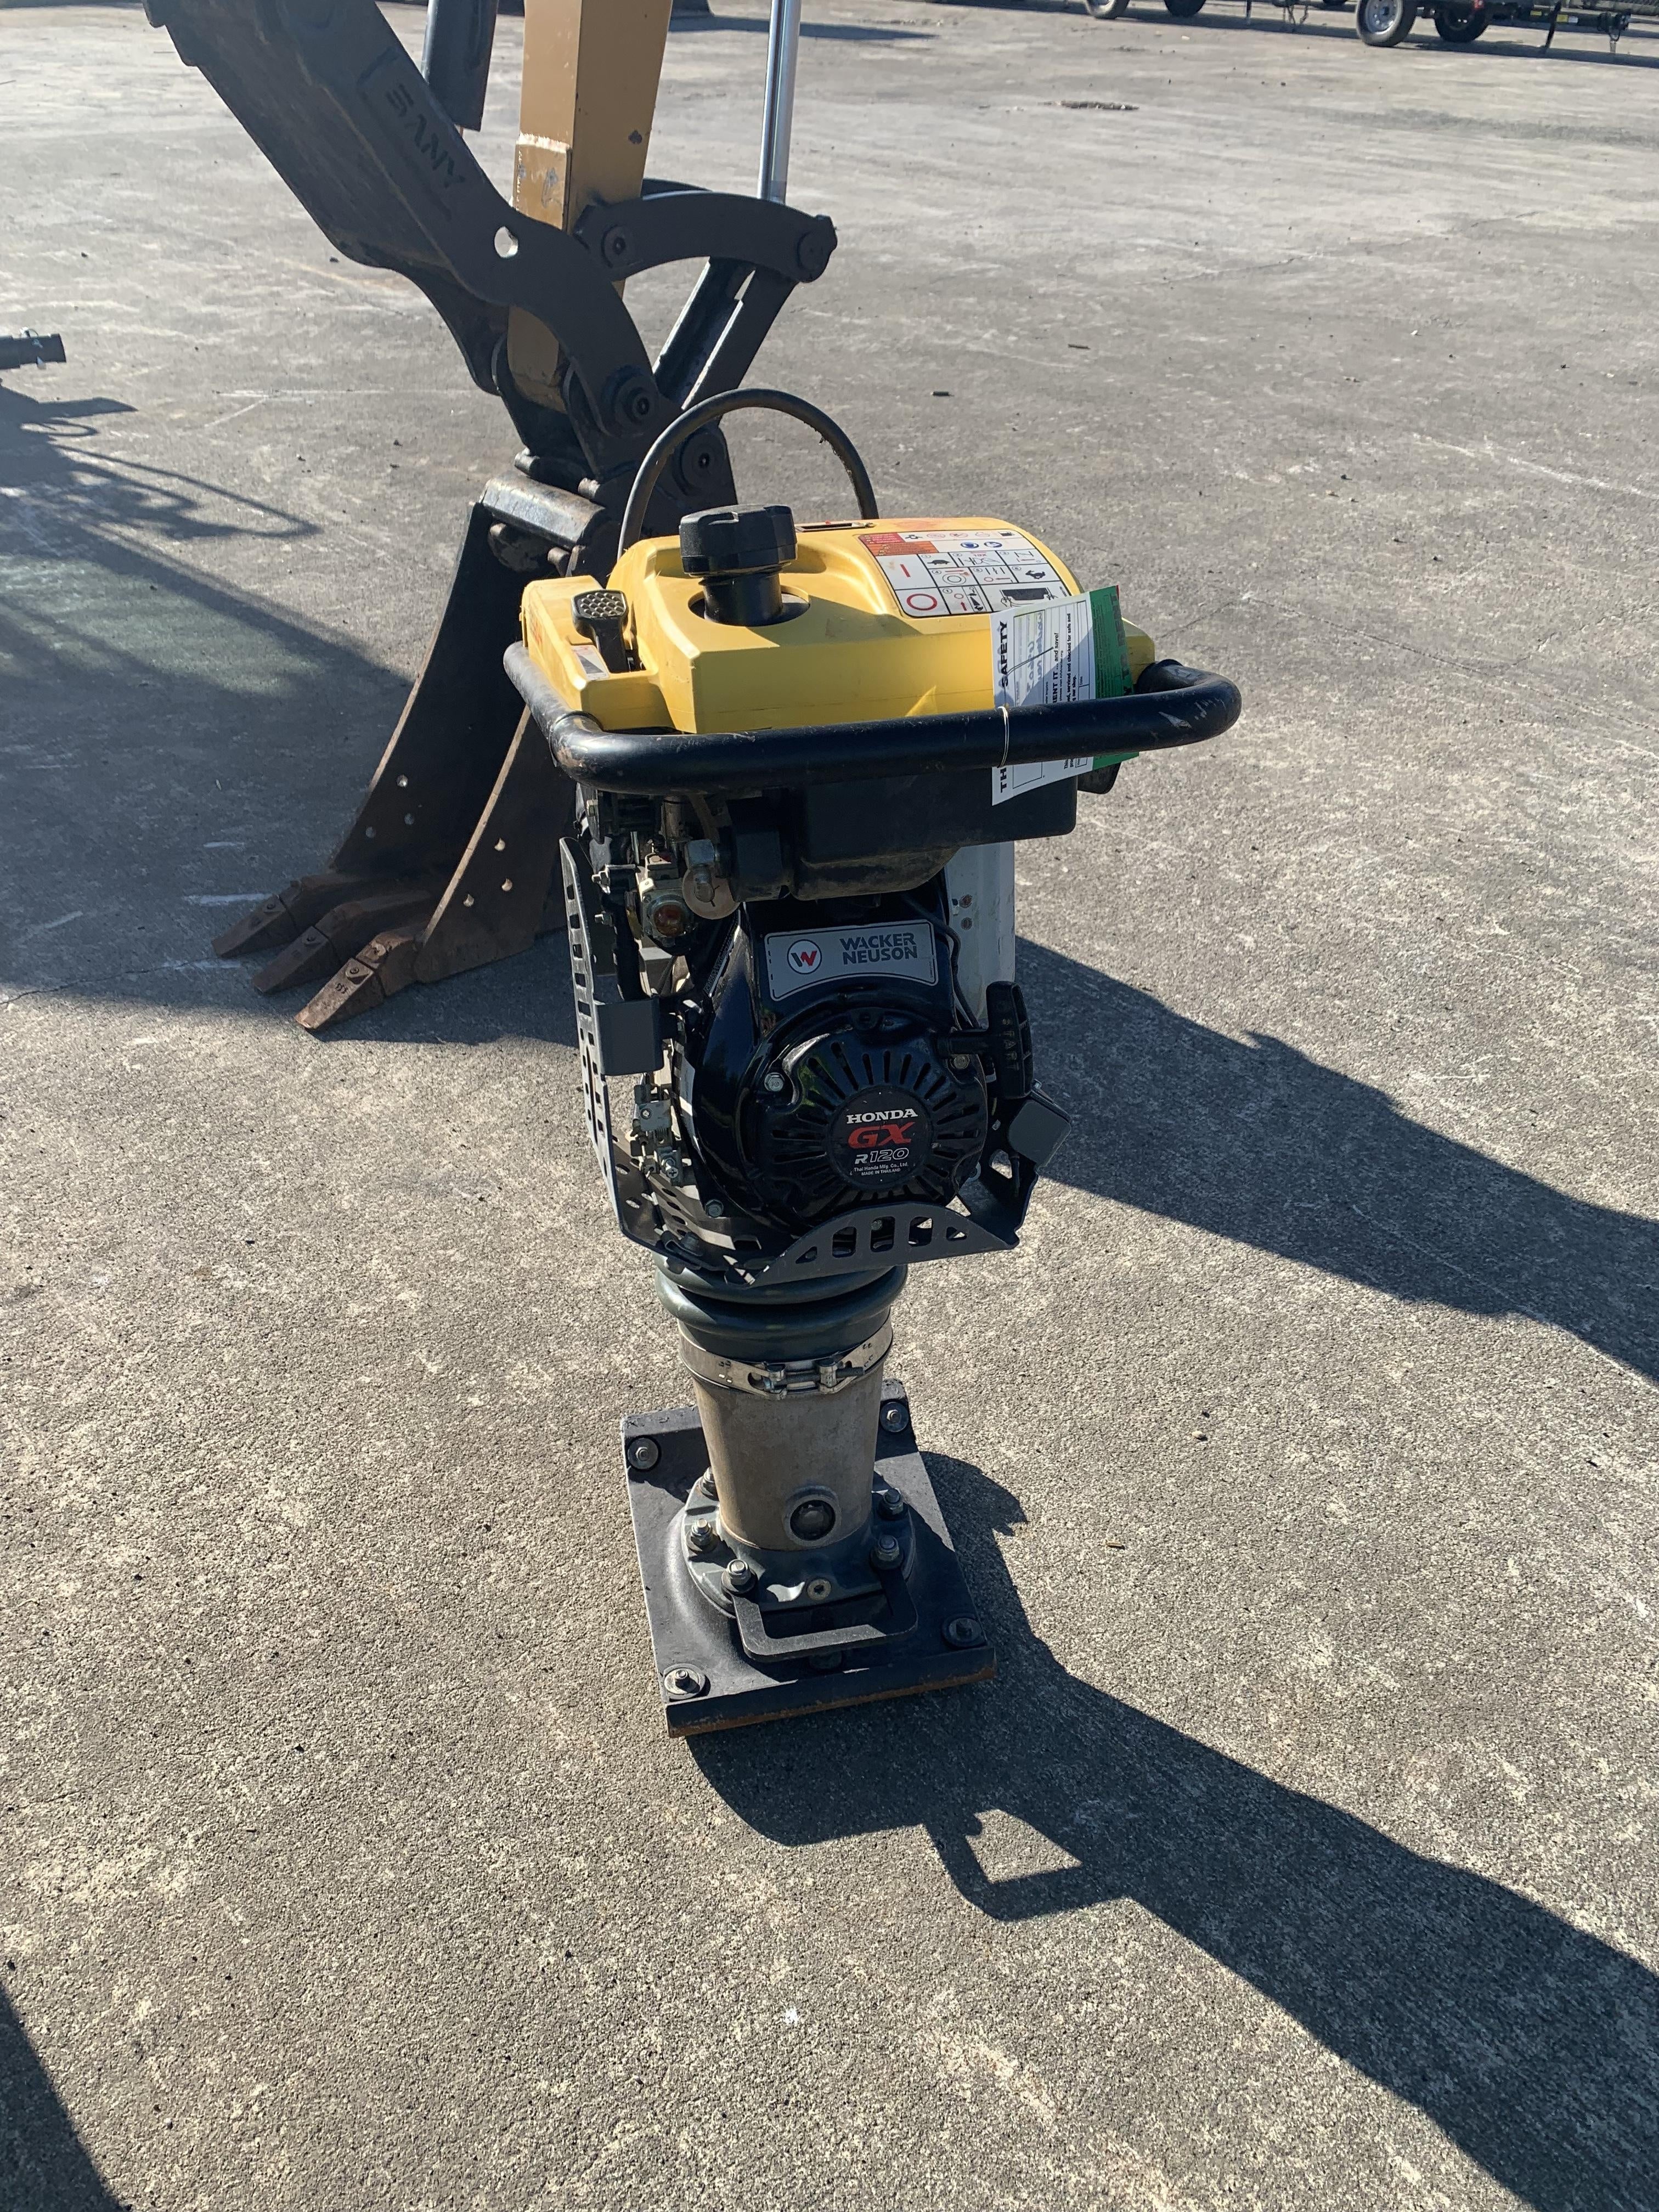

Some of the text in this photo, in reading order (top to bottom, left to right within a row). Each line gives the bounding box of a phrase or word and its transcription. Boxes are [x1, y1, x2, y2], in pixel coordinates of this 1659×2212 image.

[386, 83, 466, 188] SANY
[1000, 620, 1008, 688] SAFETY
[1053, 671, 1058, 680] IT
[839, 933, 916, 951] WACKER
[842, 945, 918, 965] NEUSON
[847, 1108, 918, 1124] HONDA
[848, 1121, 915, 1149] GX
